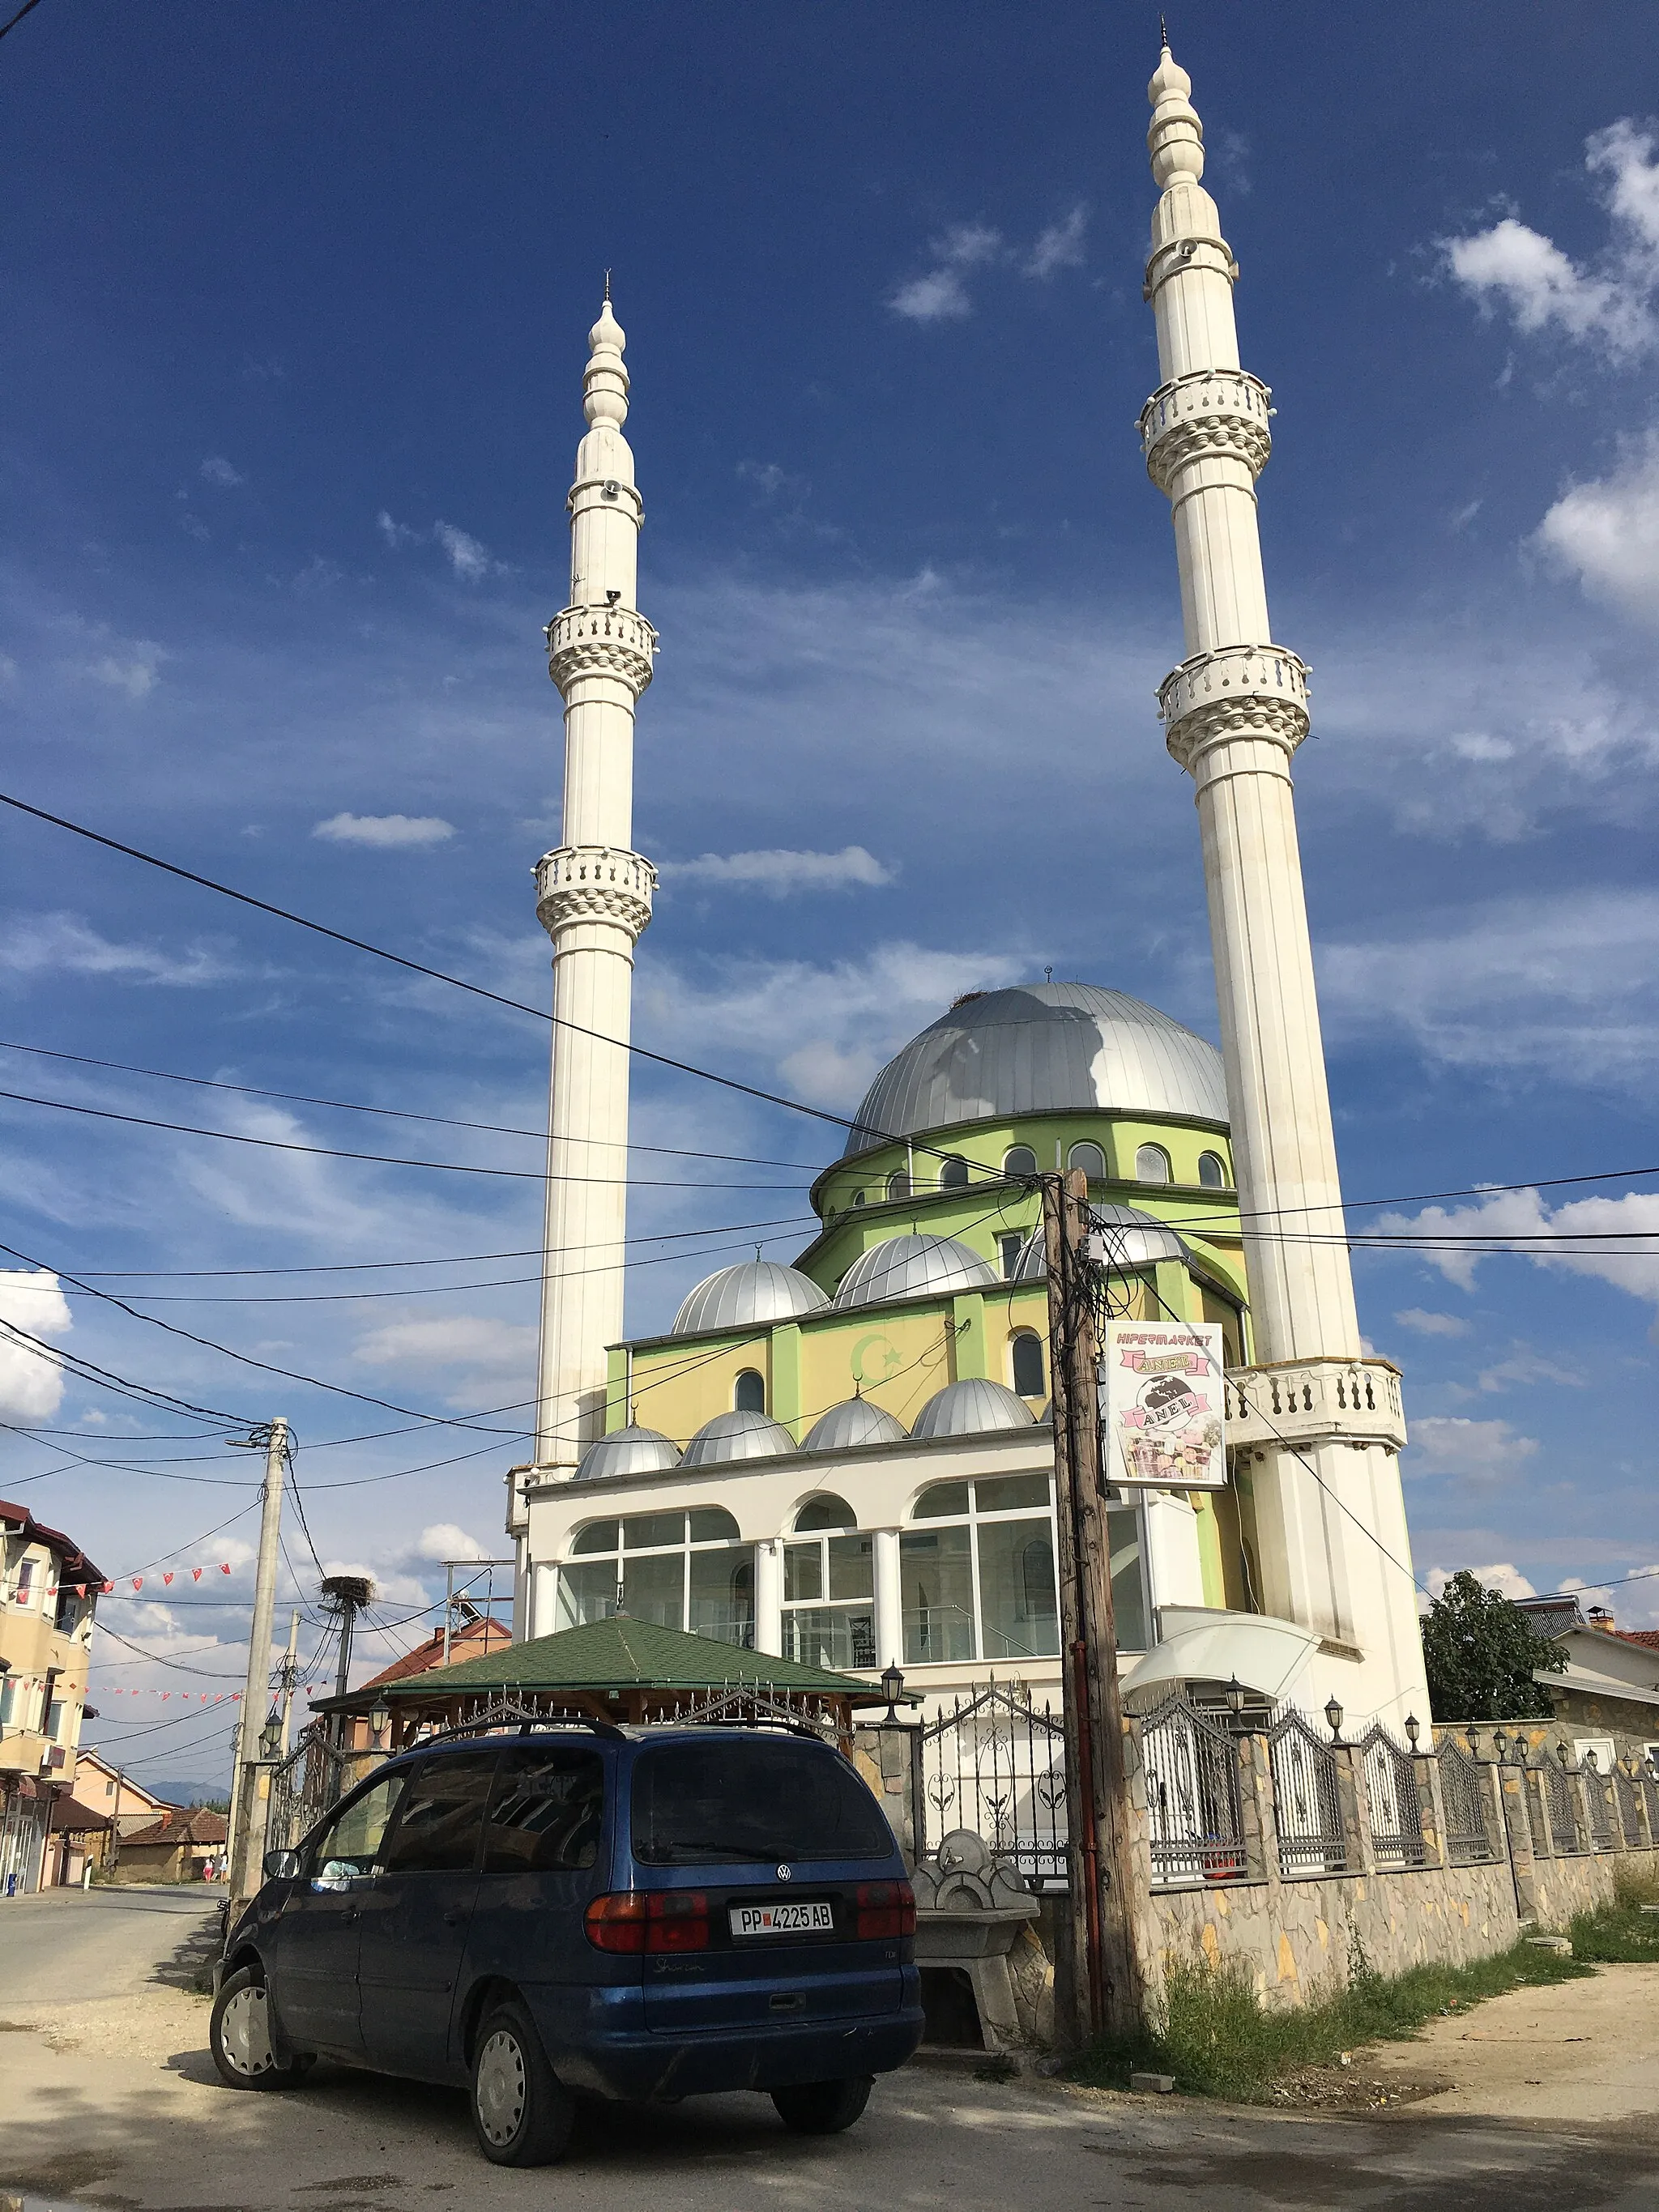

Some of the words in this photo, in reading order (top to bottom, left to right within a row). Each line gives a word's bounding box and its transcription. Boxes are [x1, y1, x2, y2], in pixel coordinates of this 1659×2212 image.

[1117, 1333, 1213, 1346] HIPERMARKET
[1137, 1354, 1192, 1372] ANEL
[1143, 1398, 1192, 1426] ANEL
[741, 1910, 761, 1932] PP
